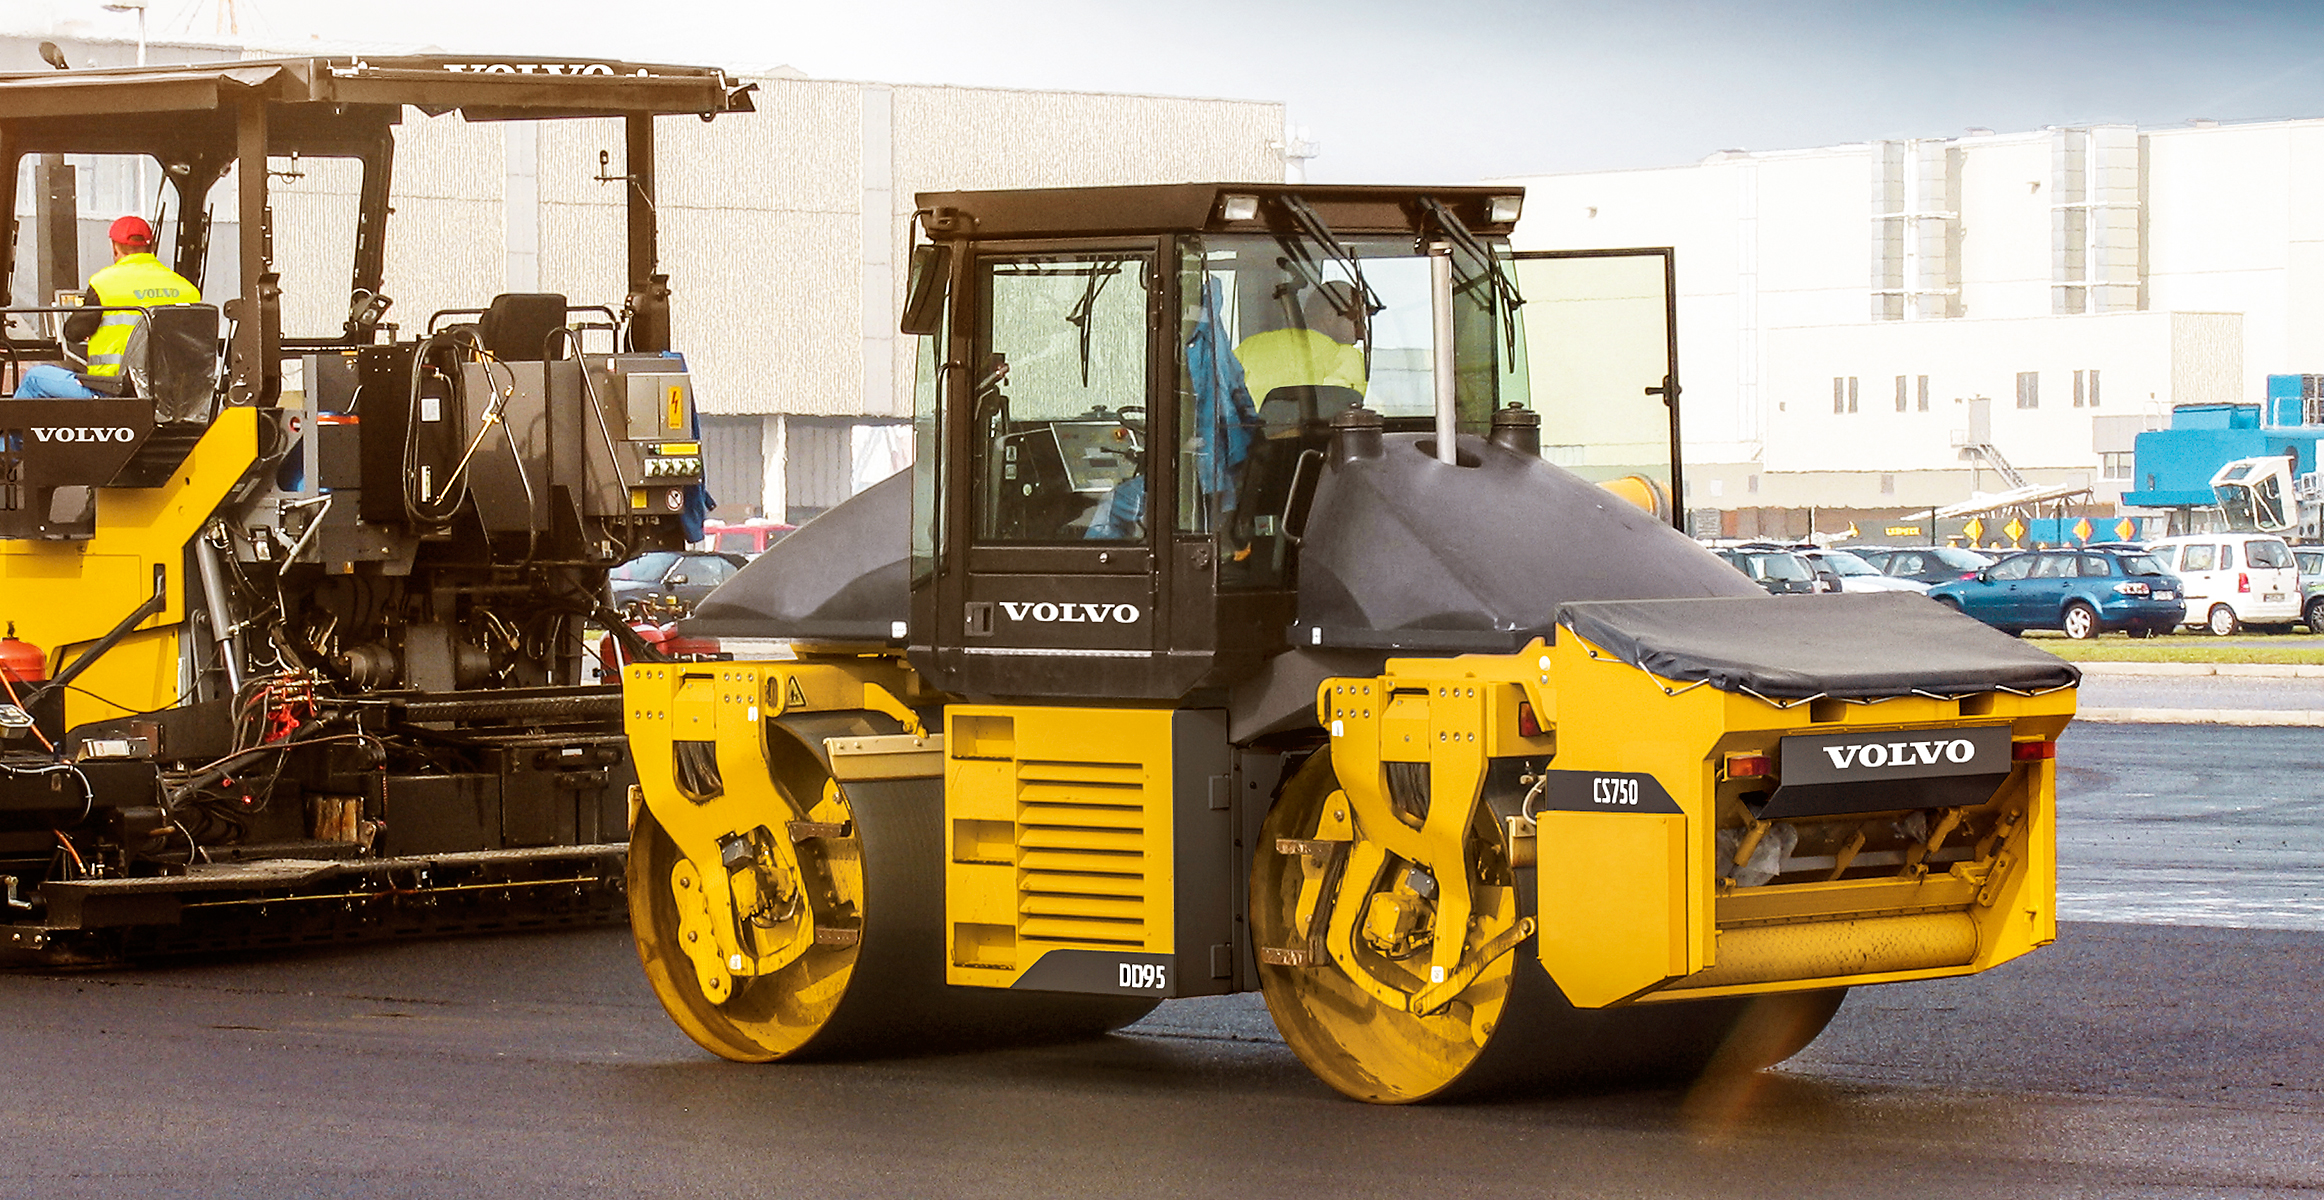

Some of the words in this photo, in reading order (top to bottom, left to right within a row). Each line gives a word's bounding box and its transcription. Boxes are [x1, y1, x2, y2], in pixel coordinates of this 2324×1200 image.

[133, 287, 180, 300] VOLVO
[31, 427, 135, 443] VOLVO
[998, 601, 1140, 624] VOLVO
[1822, 739, 1976, 769] VOLVO
[1593, 777, 1639, 805] CS750
[1119, 962, 1167, 989] DD95
